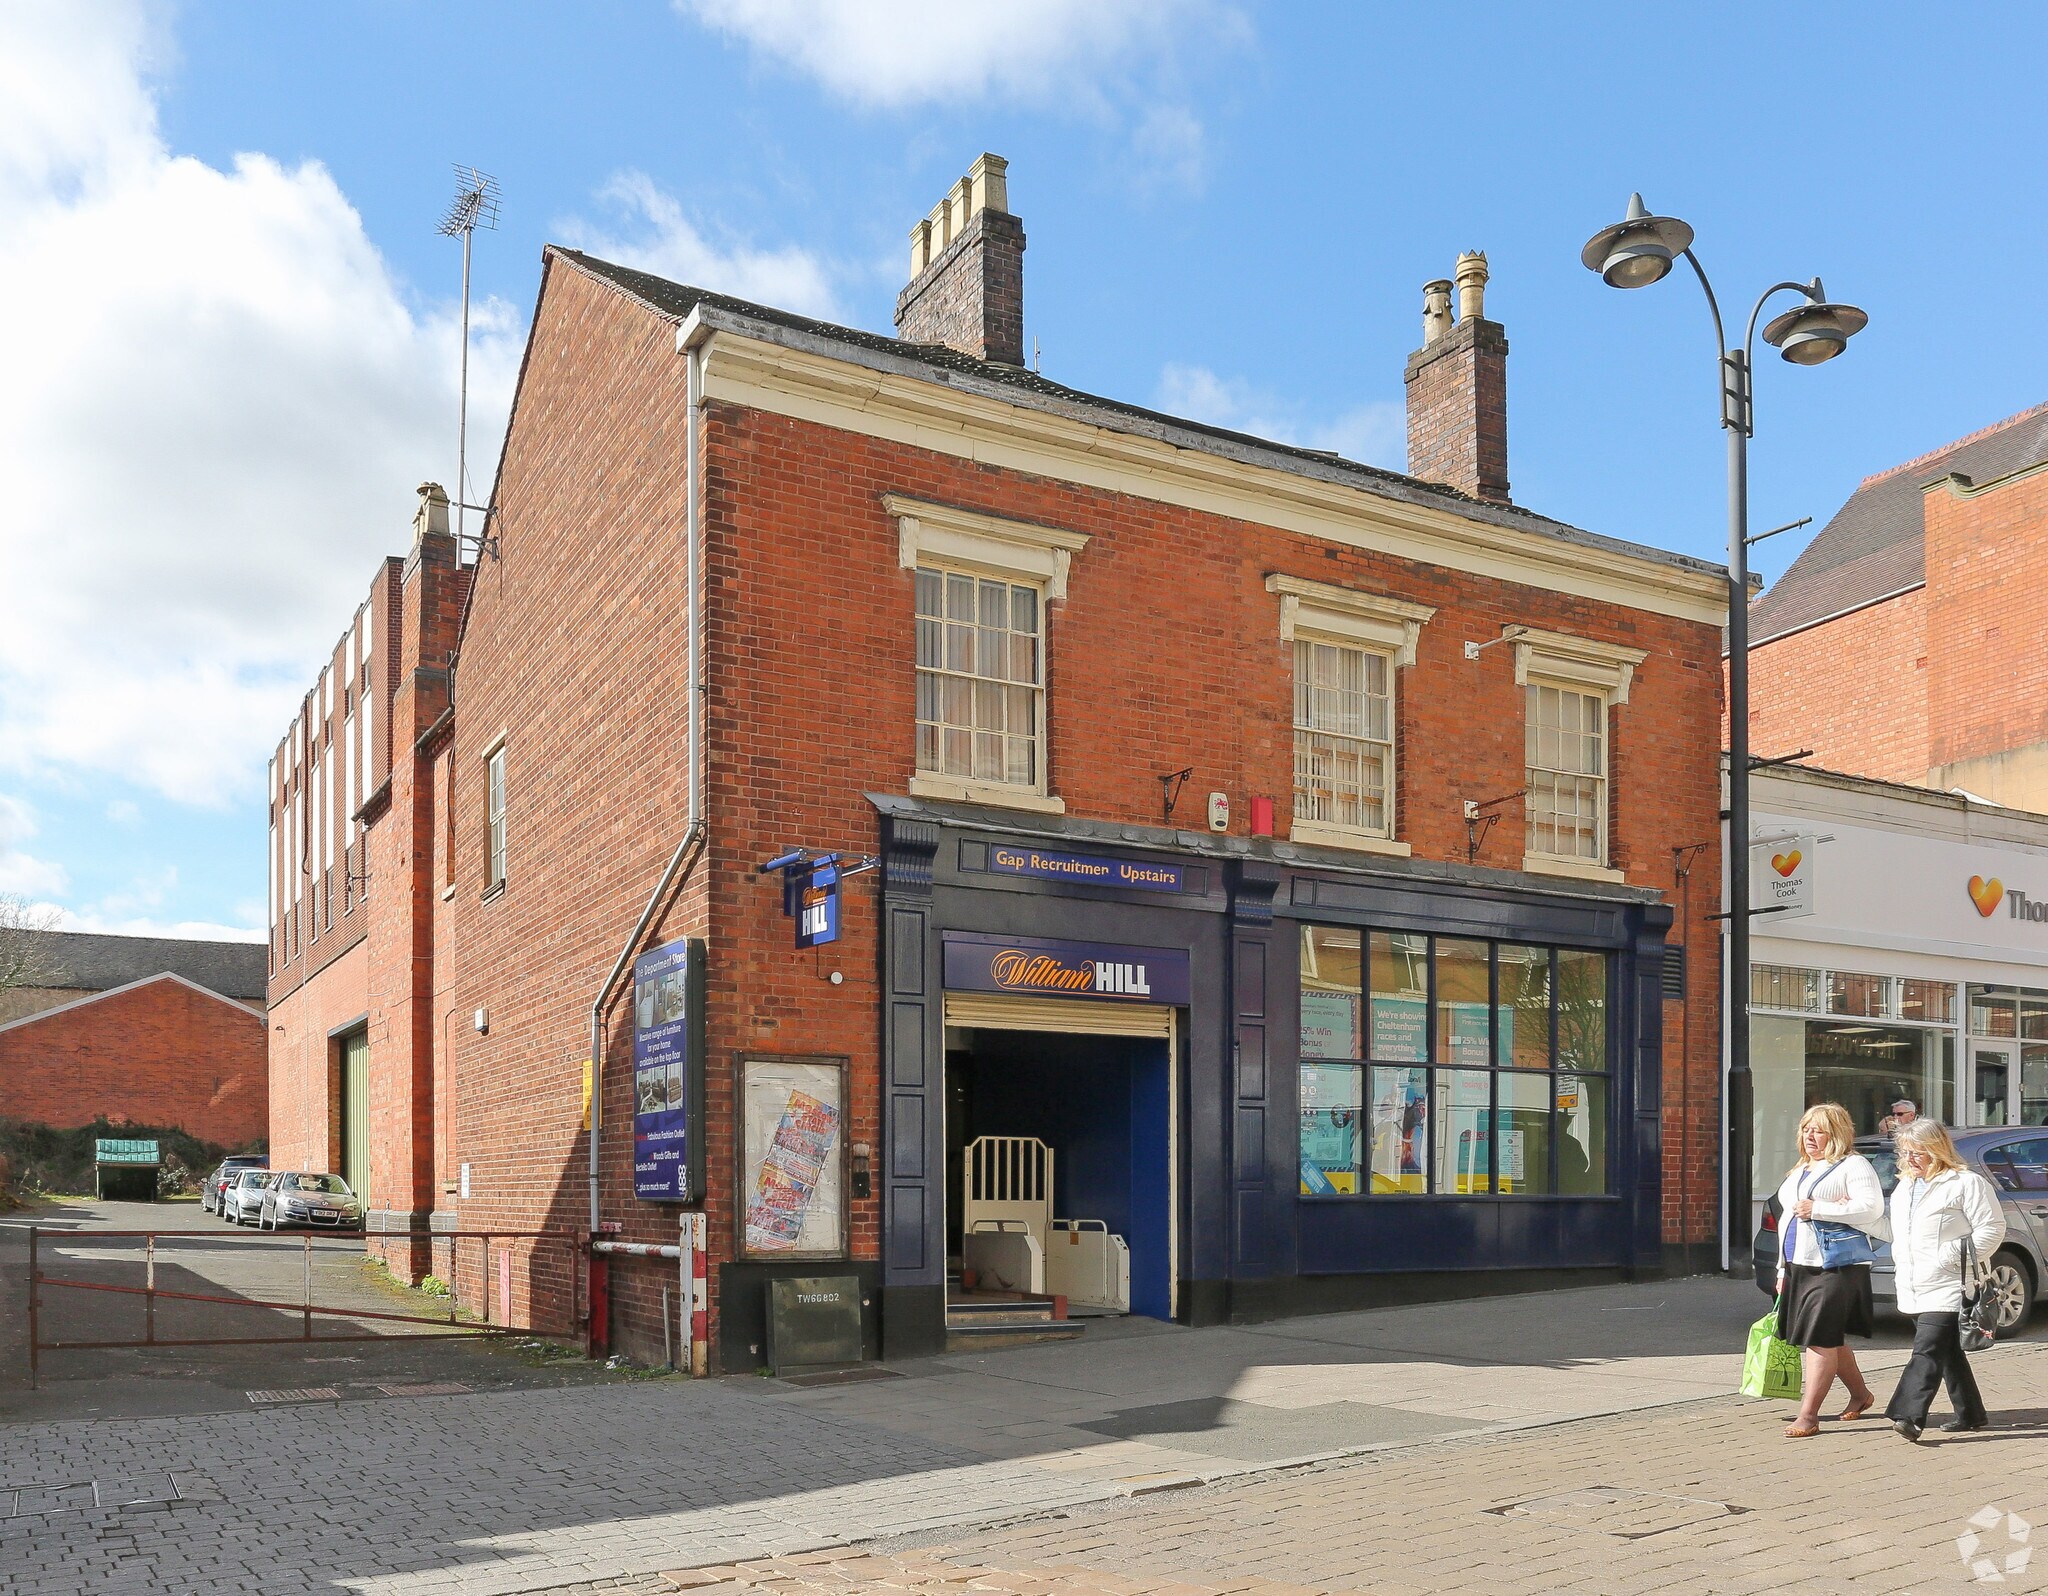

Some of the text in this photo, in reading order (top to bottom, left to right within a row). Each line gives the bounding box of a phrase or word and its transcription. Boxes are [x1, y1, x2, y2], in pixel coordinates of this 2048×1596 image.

[996, 851, 1025, 870] Gap
[1120, 864, 1176, 884] Upstairs
[1771, 878, 1803, 890] Thomas
[1776, 887, 1797, 898] Cook
[2006, 889, 2048, 923] Tho
[802, 904, 828, 936] HILL
[644, 955, 672, 976] Department
[672, 951, 685, 965] Store
[990, 949, 1150, 995] William HILL
[1377, 1010, 1398, 1019] We're
[1316, 1026, 1332, 1036] Win
[1377, 1021, 1421, 1031] Cheltenham
[1398, 1033, 1412, 1041] and
[1462, 1036, 1477, 1045] 25%
[1377, 1043, 1416, 1054] everything
[1462, 1047, 1484, 1056] Bonus
